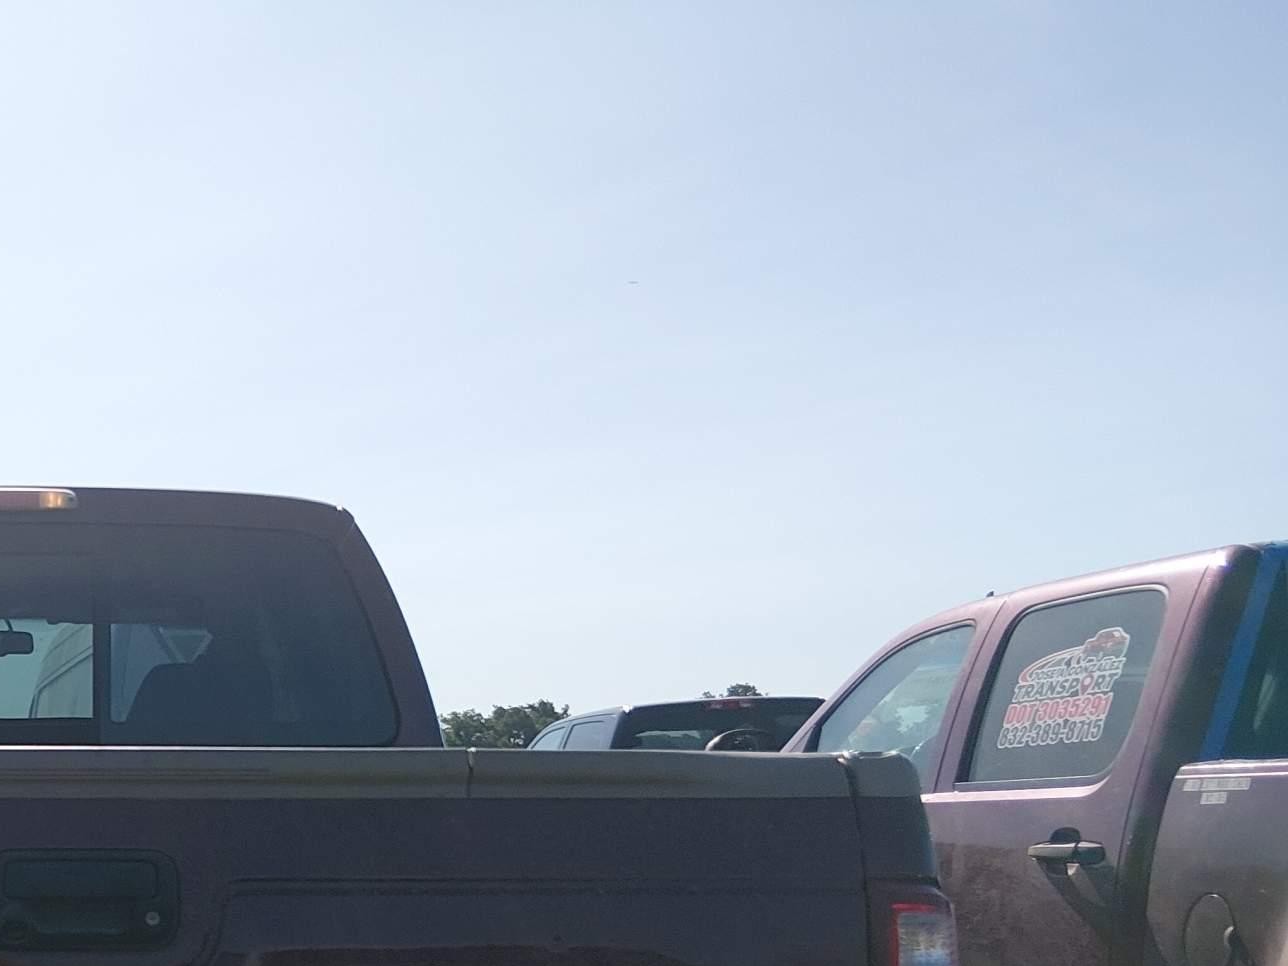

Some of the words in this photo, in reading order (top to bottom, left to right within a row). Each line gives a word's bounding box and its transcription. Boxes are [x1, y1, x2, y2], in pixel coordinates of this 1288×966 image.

[1014, 673, 1116, 701] TRANSPORT
[1005, 702, 1037, 724] DOT
[1038, 697, 1111, 722] 3035291
[999, 721, 1102, 747] 832-389-8715
